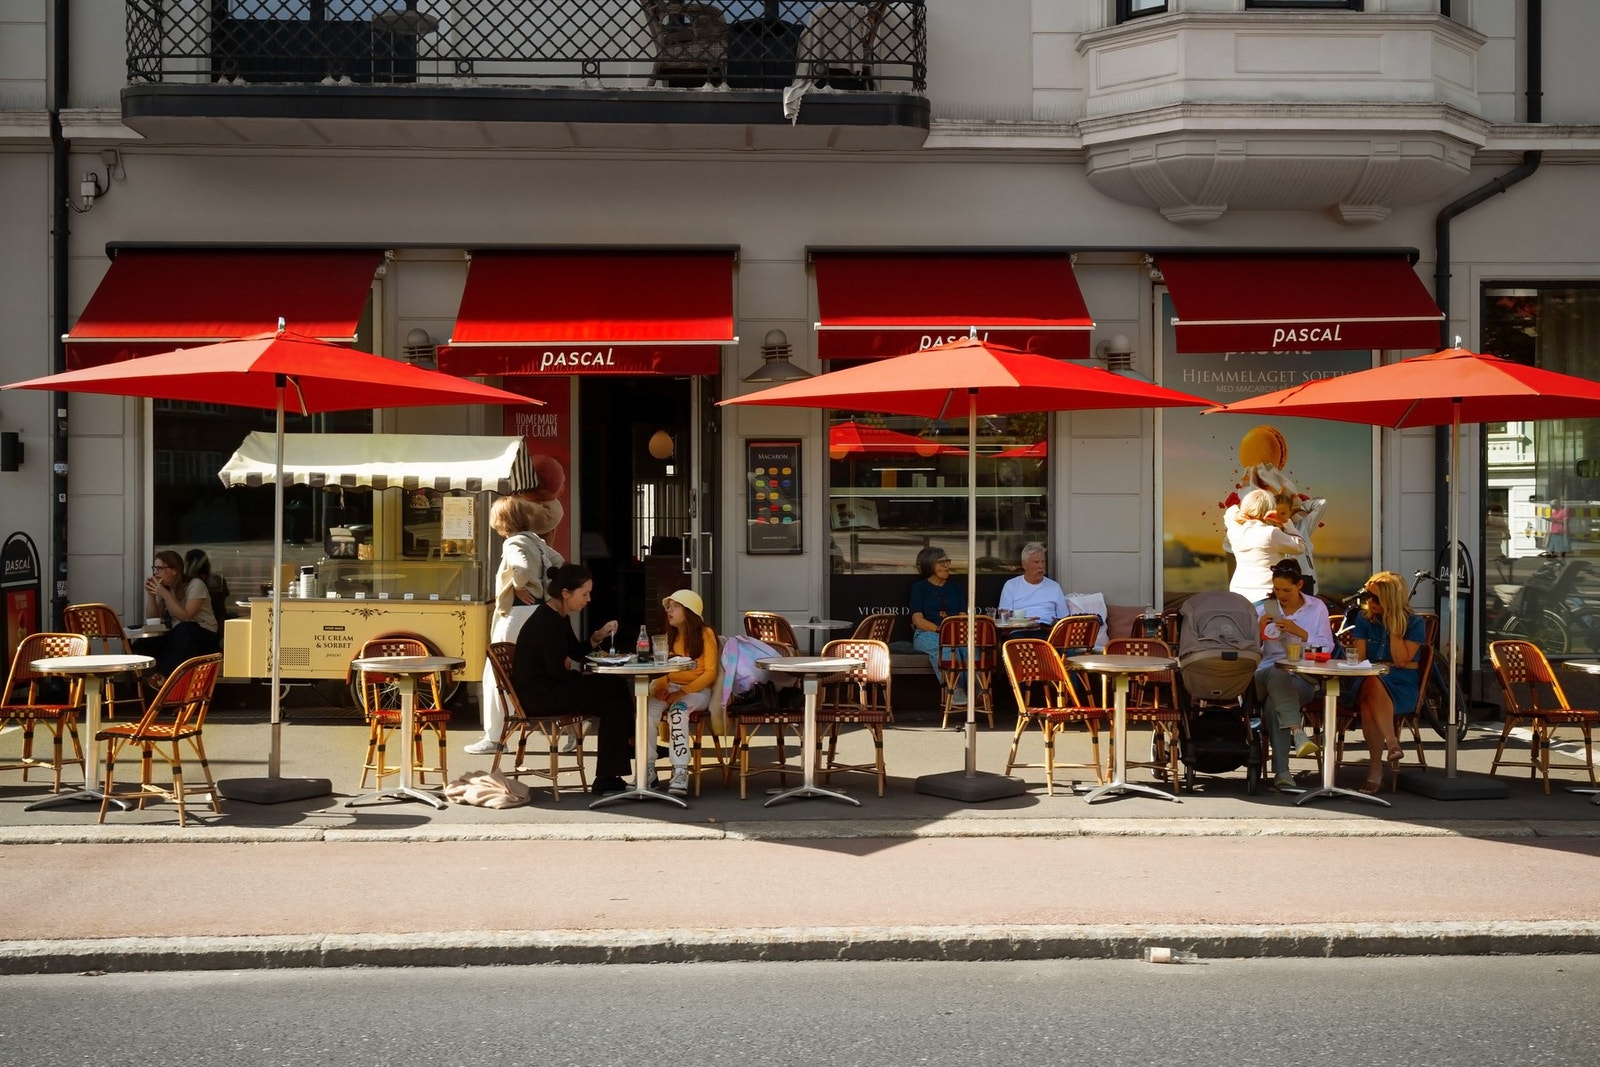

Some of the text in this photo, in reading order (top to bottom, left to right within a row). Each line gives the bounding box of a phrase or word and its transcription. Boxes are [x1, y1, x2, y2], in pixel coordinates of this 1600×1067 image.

[1182, 368, 1299, 384] HJEMMELAGET
[1216, 385, 1234, 393] MED
[1235, 384, 1278, 393] MACARON
[515, 412, 558, 425] HOMEMADE
[516, 424, 558, 437] ICE CREAM
